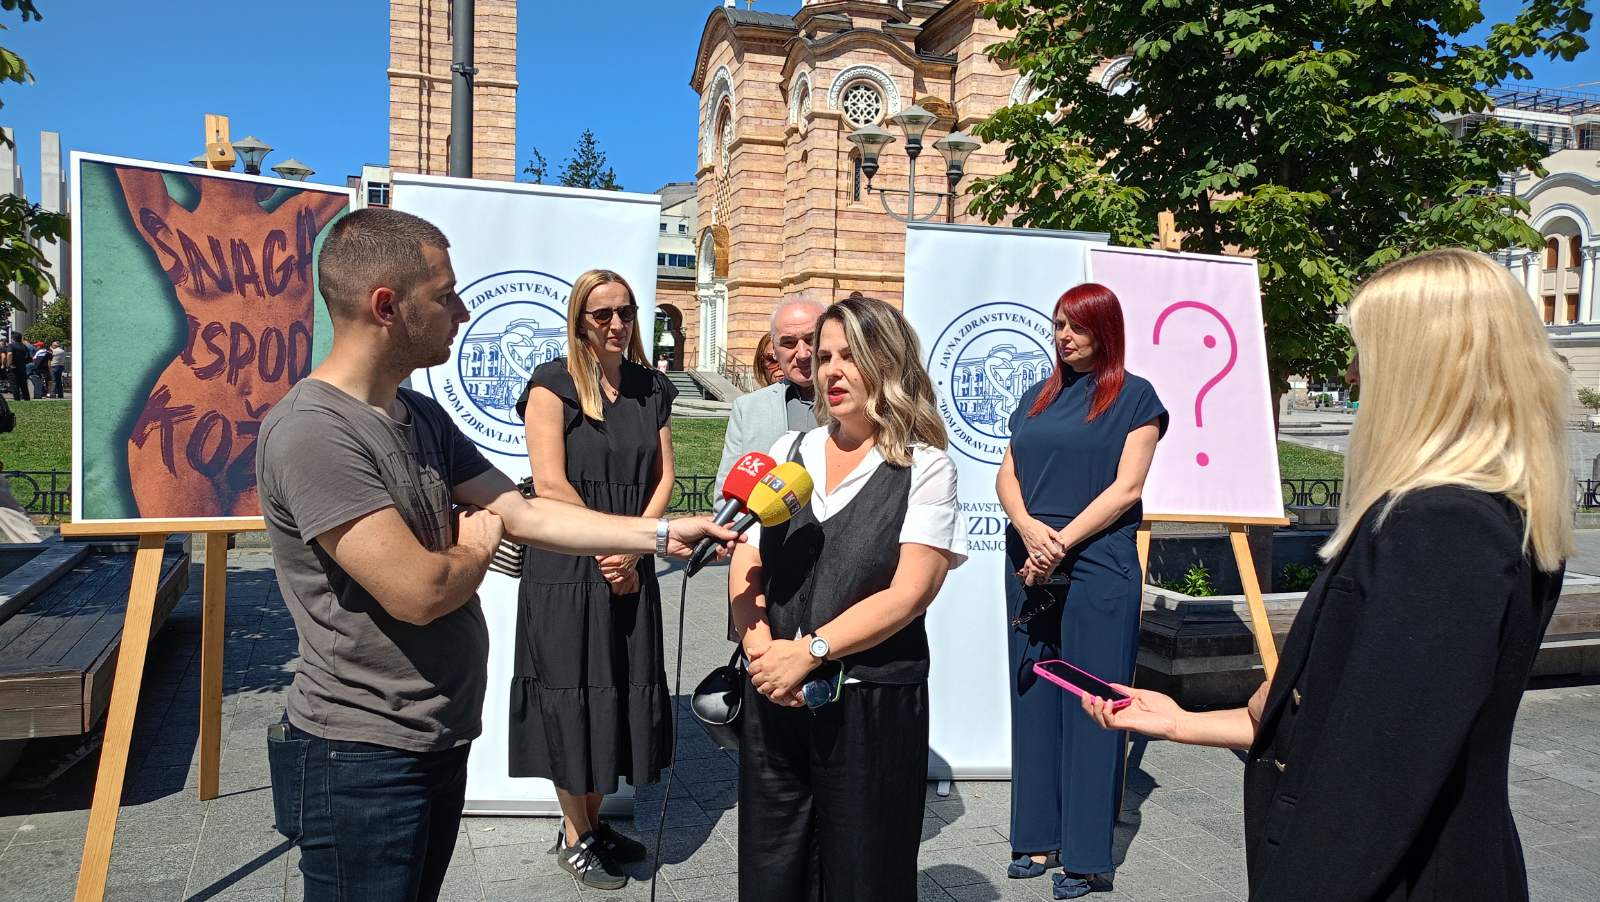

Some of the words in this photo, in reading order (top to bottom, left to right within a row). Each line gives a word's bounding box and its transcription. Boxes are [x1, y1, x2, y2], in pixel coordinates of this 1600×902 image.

[139, 205, 318, 300] SNAGA
[468, 282, 559, 310] ZDRAVSTVENA
[180, 313, 314, 387] ISPOD
[940, 337, 962, 368] JAVNA
[959, 312, 1032, 338] ZDRAVSTVENA
